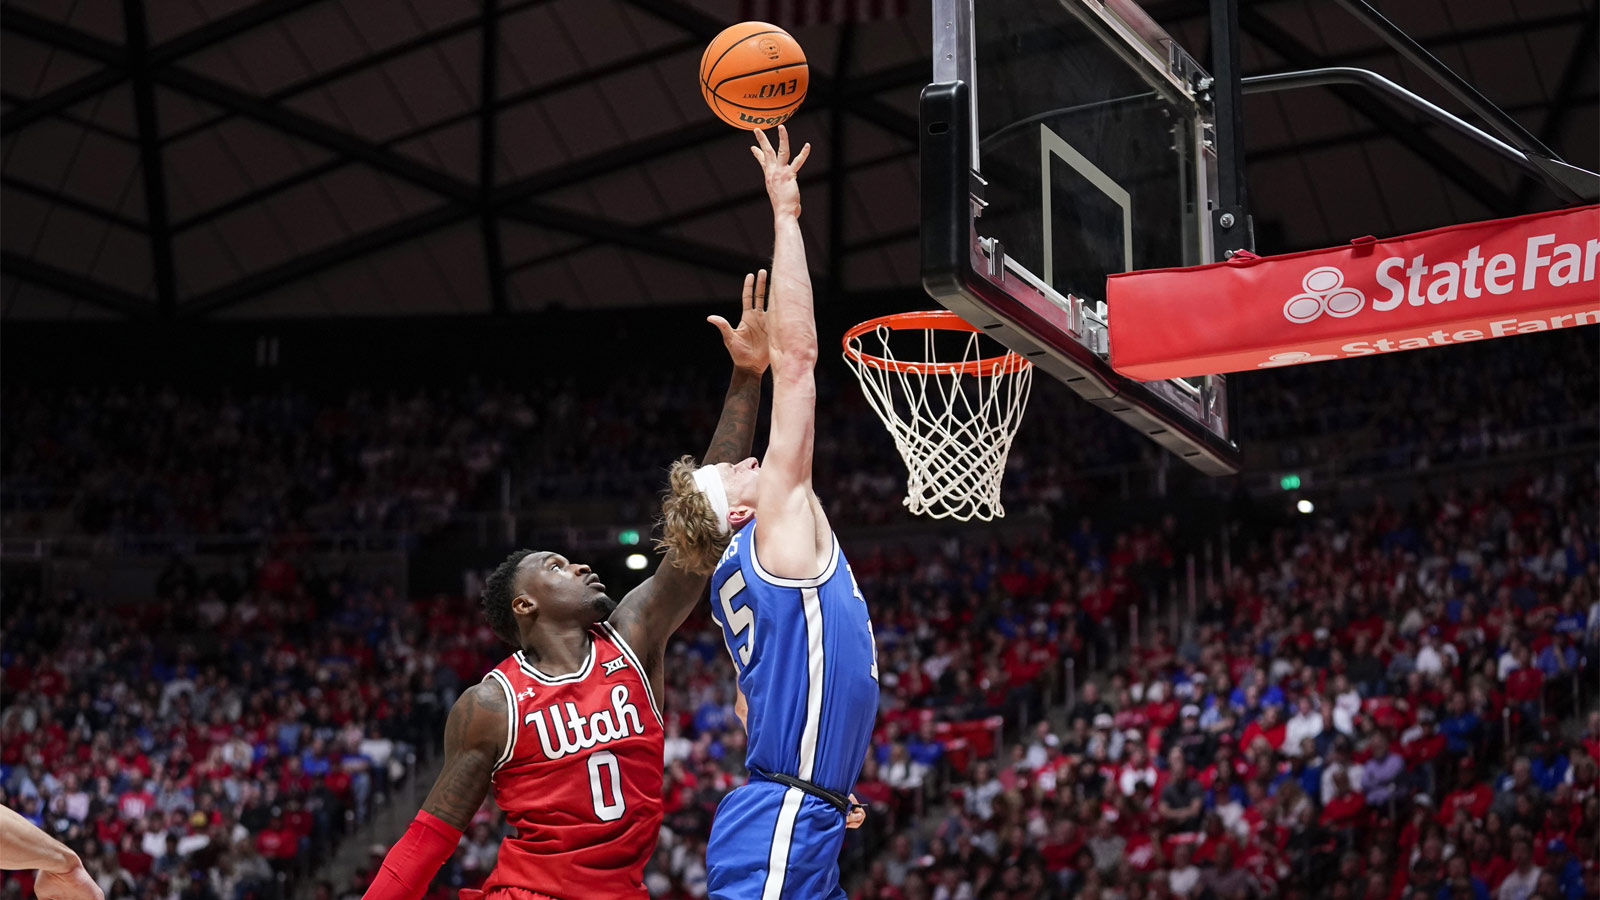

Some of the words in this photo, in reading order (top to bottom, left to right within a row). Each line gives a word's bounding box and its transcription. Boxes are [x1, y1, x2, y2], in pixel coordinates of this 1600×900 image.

[759, 79, 798, 98] EVO
[1372, 245, 1516, 311] State
[1341, 329, 1484, 357] State
[524, 684, 645, 760] Utah
[586, 750, 626, 822] 0
